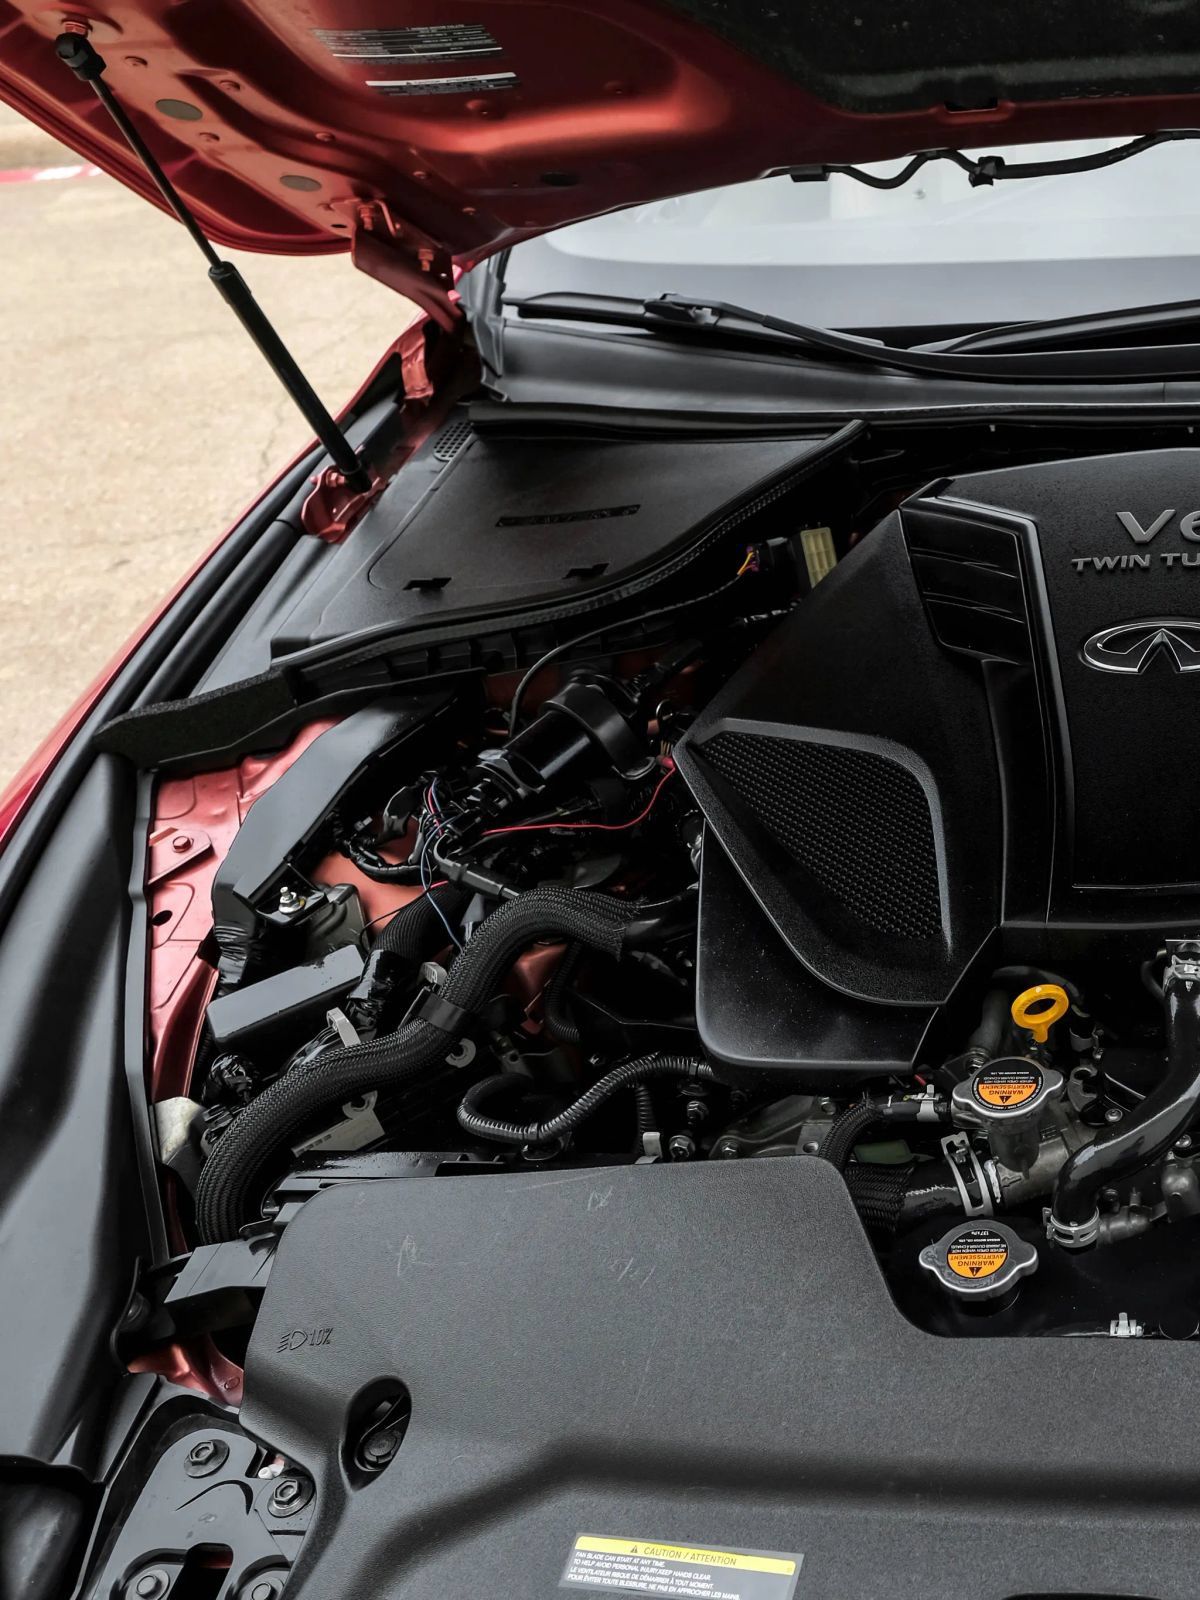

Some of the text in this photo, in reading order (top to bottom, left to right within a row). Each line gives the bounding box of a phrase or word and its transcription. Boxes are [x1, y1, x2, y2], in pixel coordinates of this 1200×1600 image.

[1071, 554, 1150, 572] TWIN
[644, 1547, 682, 1559] CAUTION
[690, 1553, 737, 1566] ATTENTION
[612, 1562, 639, 1571] PERSONAL
